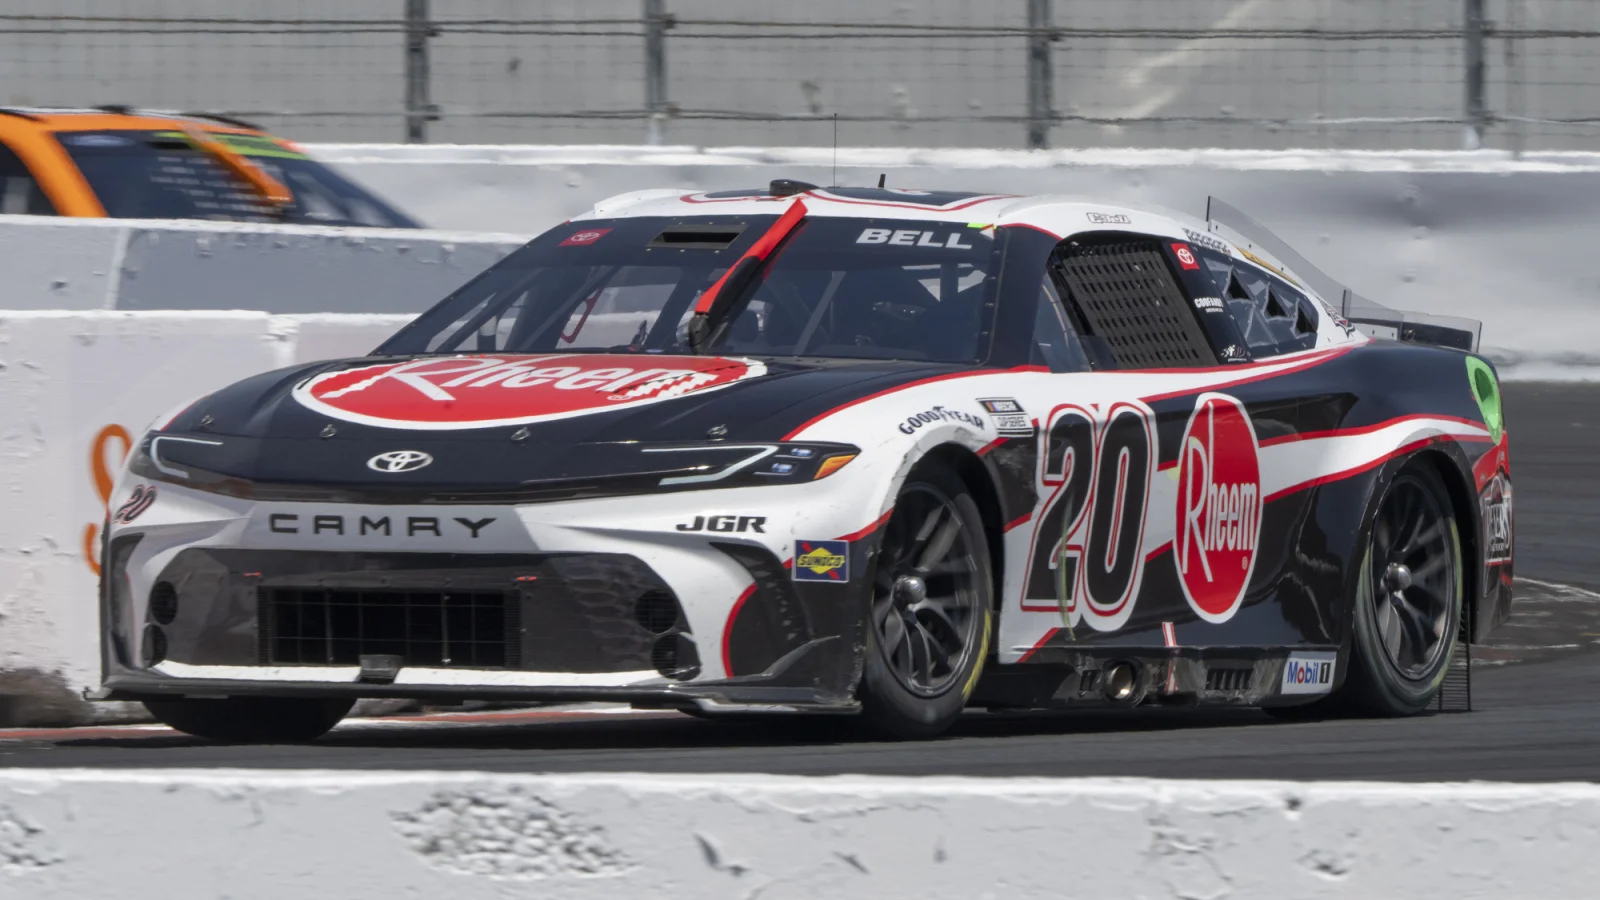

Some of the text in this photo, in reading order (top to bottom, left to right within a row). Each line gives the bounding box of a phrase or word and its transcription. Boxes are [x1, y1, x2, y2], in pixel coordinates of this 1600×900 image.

[856, 228, 972, 249] BELL
[319, 355, 718, 401] Rheem
[899, 406, 985, 434] GOODYEAR
[114, 485, 158, 524] 20
[1182, 401, 1257, 582] Rheem
[1020, 402, 1153, 618] 20
[269, 514, 498, 538] CAMRY
[676, 515, 767, 533] JGR
[799, 556, 843, 566] SUNOCO
[1287, 661, 1331, 684] Mobil 1
